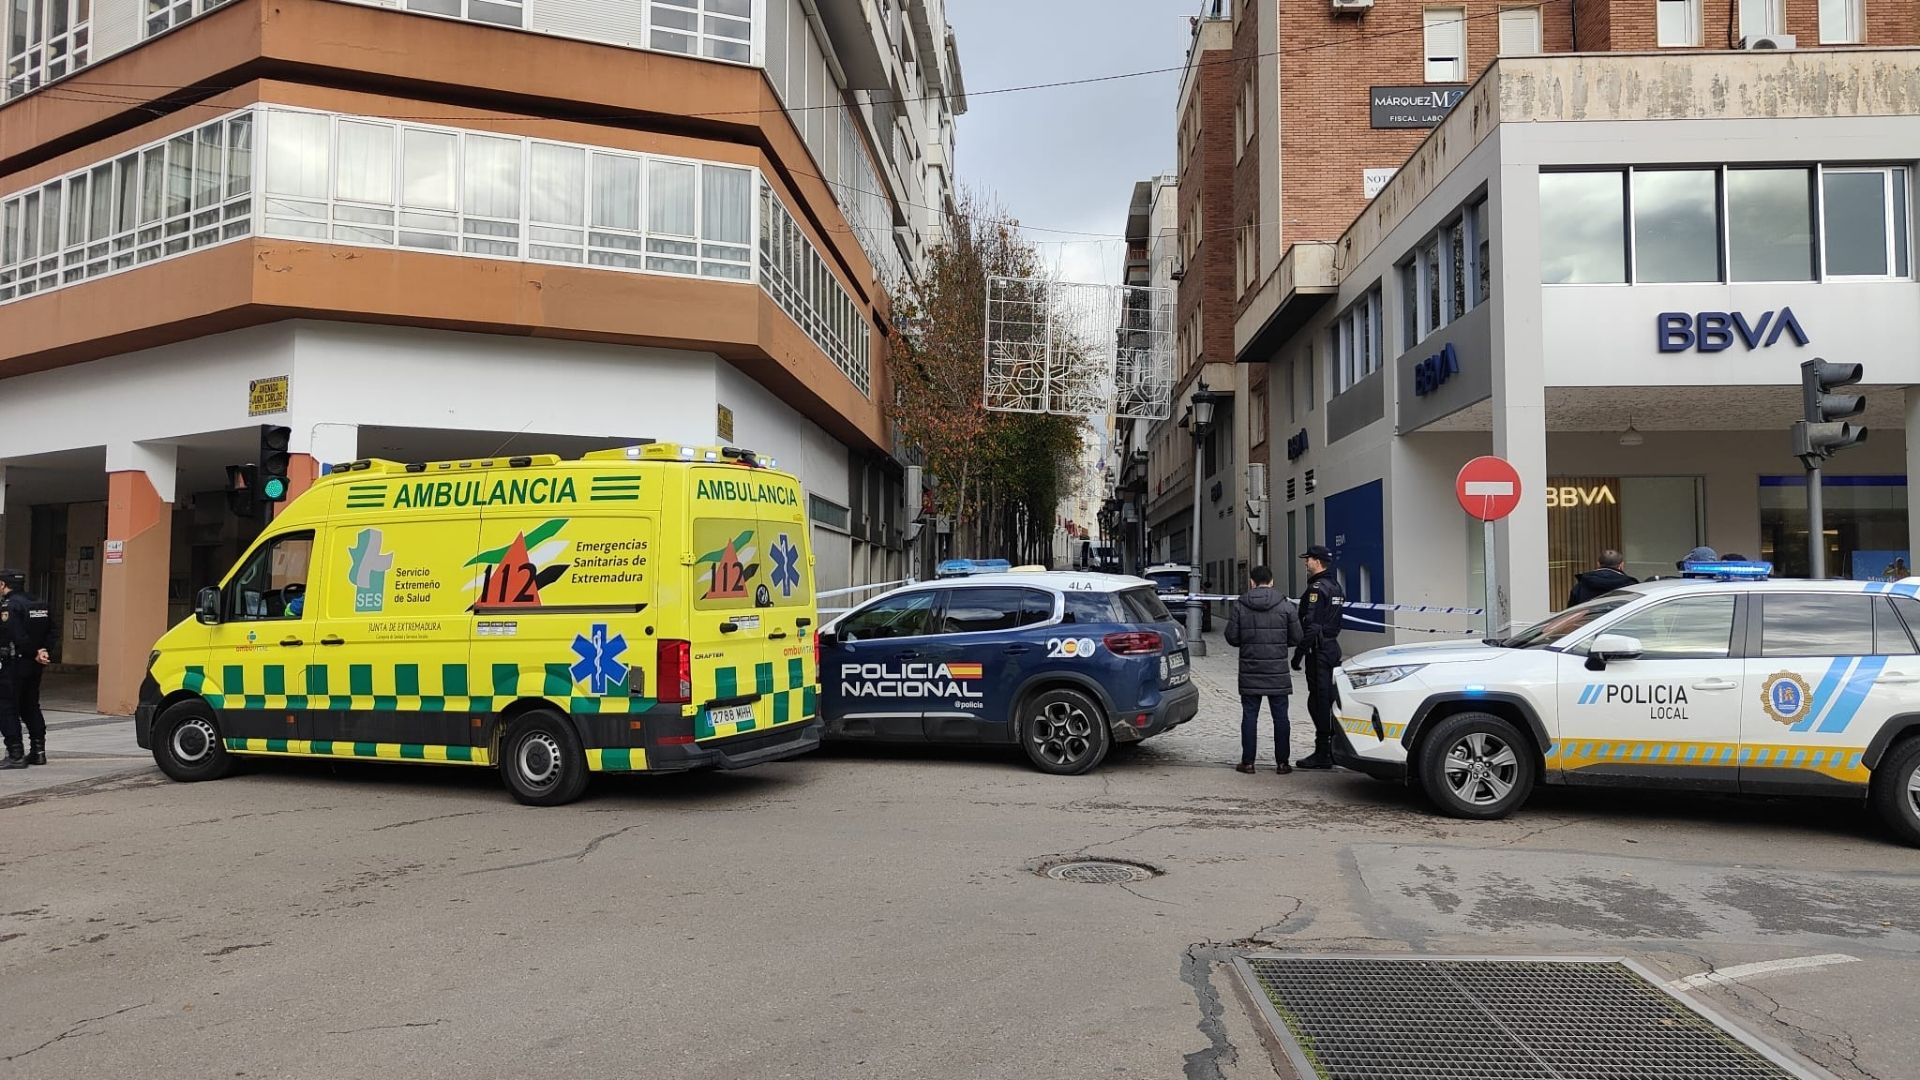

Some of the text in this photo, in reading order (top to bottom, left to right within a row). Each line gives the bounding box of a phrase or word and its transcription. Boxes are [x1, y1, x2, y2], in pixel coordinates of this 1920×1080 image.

[1374, 95, 1431, 106] MÁRQUEZ
[1366, 175, 1392, 184] NOT
[1657, 306, 1811, 353] BBVA
[1415, 342, 1459, 397] BBVA
[393, 476, 577, 509] AMBULANCIA
[697, 479, 798, 507] AMBULANCIA
[1545, 485, 1616, 507] BBVA
[576, 539, 648, 553] Emergencias
[574, 555, 647, 568] Sanitarias de
[396, 567, 430, 578] Servicio
[571, 571, 643, 584] Extremadura
[711, 561, 744, 593] 112
[395, 580, 441, 591] Extremeño
[481, 563, 537, 603] 112
[1069, 581, 1092, 590] 4LA
[356, 592, 382, 607] SES
[394, 592, 430, 603] de Salud
[368, 621, 442, 633] JUNTA DE EXTREMADURA
[1047, 637, 1096, 657] 200
[695, 652, 724, 660] CRAFTER
[841, 663, 953, 679] POLICIA
[841, 681, 983, 697] NACIONAL
[1606, 684, 1688, 704] POLICIA
[954, 700, 984, 710] @policia
[712, 708, 752, 724] 2788 MHH
[1650, 706, 1689, 720] LOCAL
